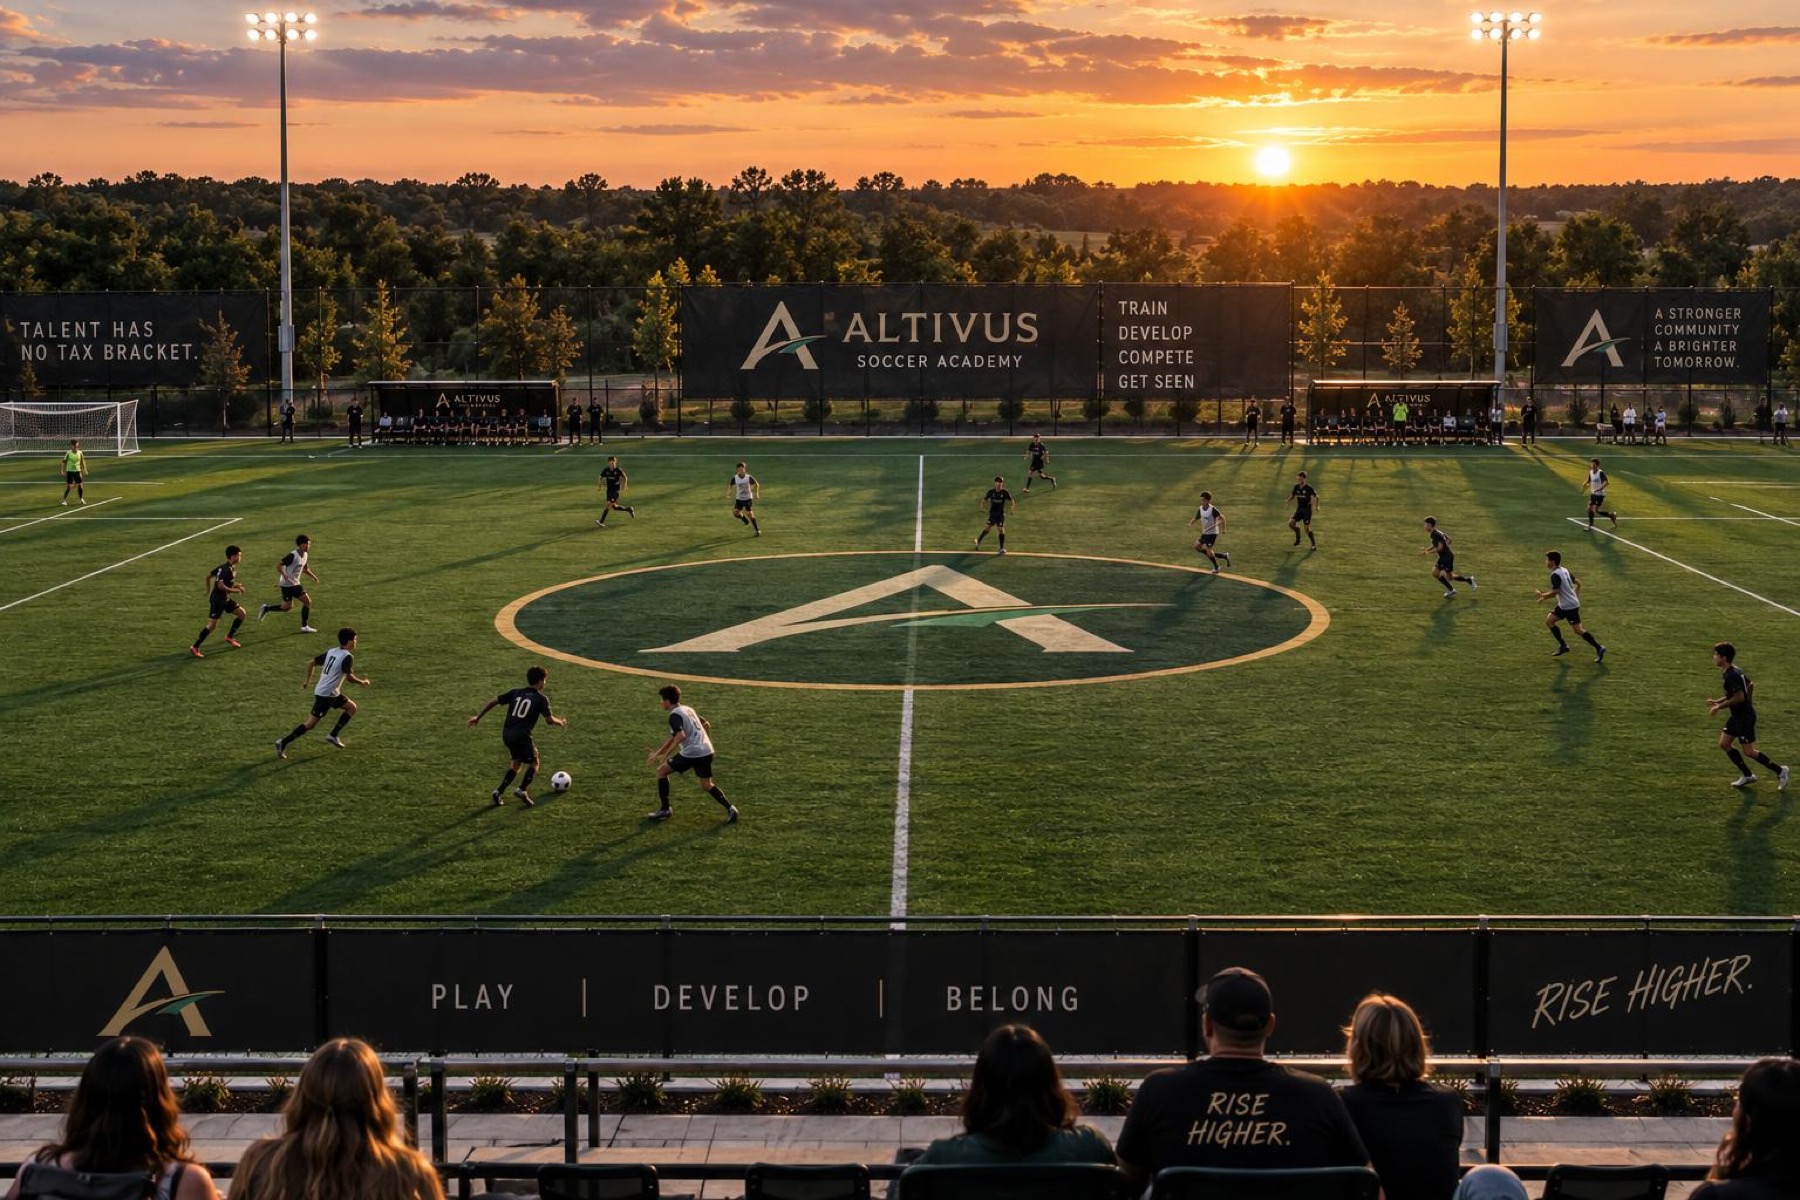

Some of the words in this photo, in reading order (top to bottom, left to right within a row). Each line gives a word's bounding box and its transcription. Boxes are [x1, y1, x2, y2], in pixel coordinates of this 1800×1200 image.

[1118, 300, 1167, 316] TRAIN
[1654, 307, 1664, 320] A
[1669, 307, 1741, 320] STRONGER
[19, 321, 101, 339] TALENT
[113, 320, 153, 338] HAS
[842, 312, 1039, 343] ALTIVUS
[1118, 325, 1193, 341] DEVELOP
[1654, 324, 1740, 336] COMMUNITY
[21, 344, 47, 364] NO
[57, 343, 94, 361] TAX
[103, 343, 198, 361] BRACKET.
[1654, 340, 1663, 352] A
[1669, 340, 1737, 352] BRIGHTER
[857, 354, 928, 368] SOCCER
[937, 354, 1022, 368] ACADEMY
[1118, 349, 1194, 365] COMPETE
[1654, 355, 1740, 368] TOMORROW.
[1118, 374, 1149, 389] GET
[1154, 374, 1194, 389] SEEN
[454, 394, 500, 403] ALTIVUS
[511, 696, 532, 719] 10
[432, 983, 513, 1010] PLAY
[654, 984, 809, 1011] DEVELOP
[947, 985, 1078, 1012] BELONG
[1531, 976, 1618, 1029] RISE
[1627, 954, 1753, 1014] HIGHER.
[1207, 1092, 1270, 1116] RISE
[1187, 1120, 1291, 1149] HIGHER.
